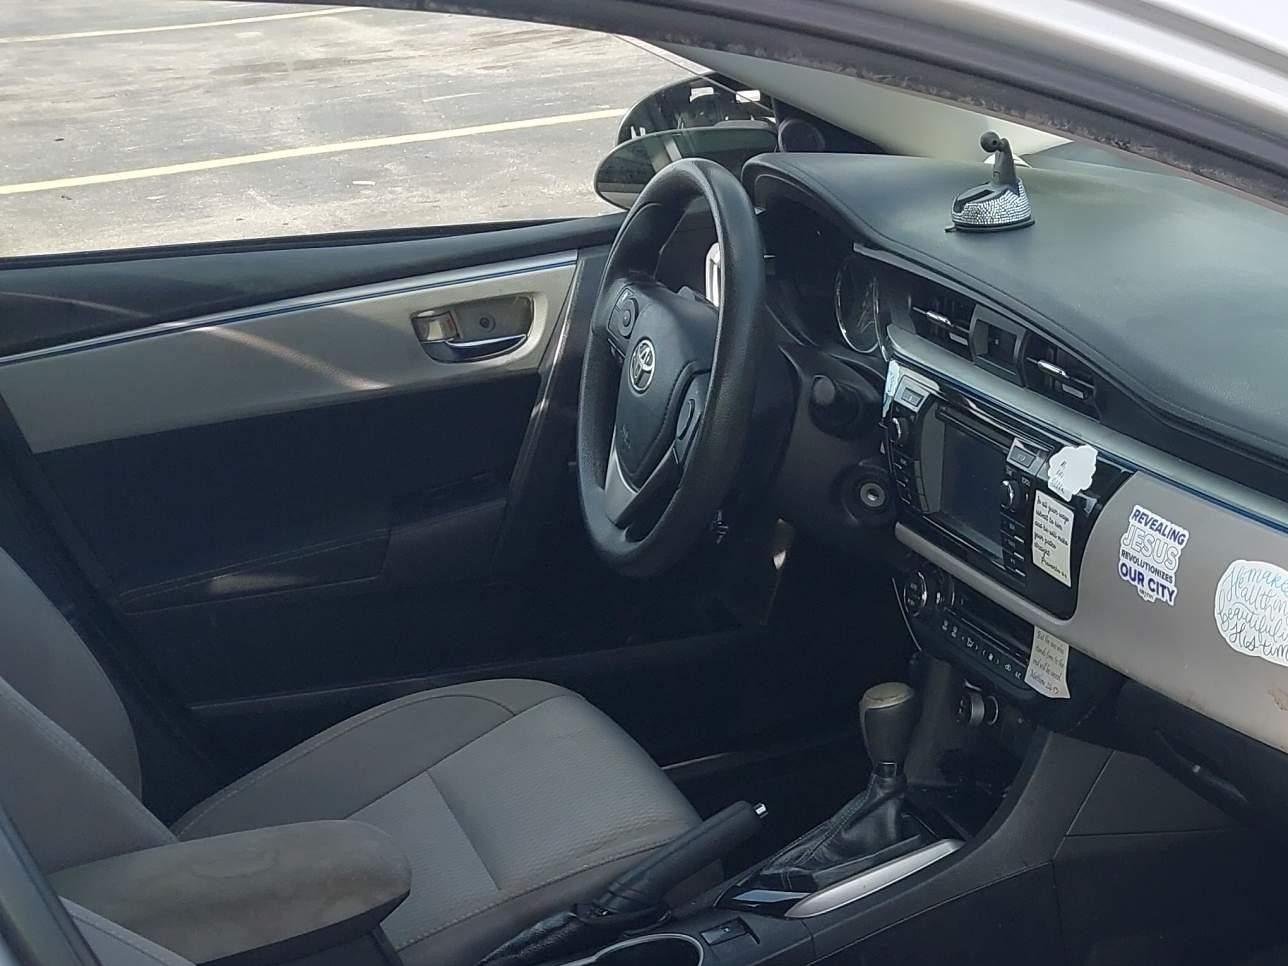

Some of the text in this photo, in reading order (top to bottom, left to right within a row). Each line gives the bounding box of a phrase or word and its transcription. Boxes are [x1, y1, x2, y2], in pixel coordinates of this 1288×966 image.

[1132, 509, 1186, 545] REVEALING
[1123, 525, 1179, 570] JESUS
[1120, 563, 1145, 587] OUR
[1147, 577, 1175, 602] CITY
[1121, 550, 1173, 584] REVOLUTIONIZES
